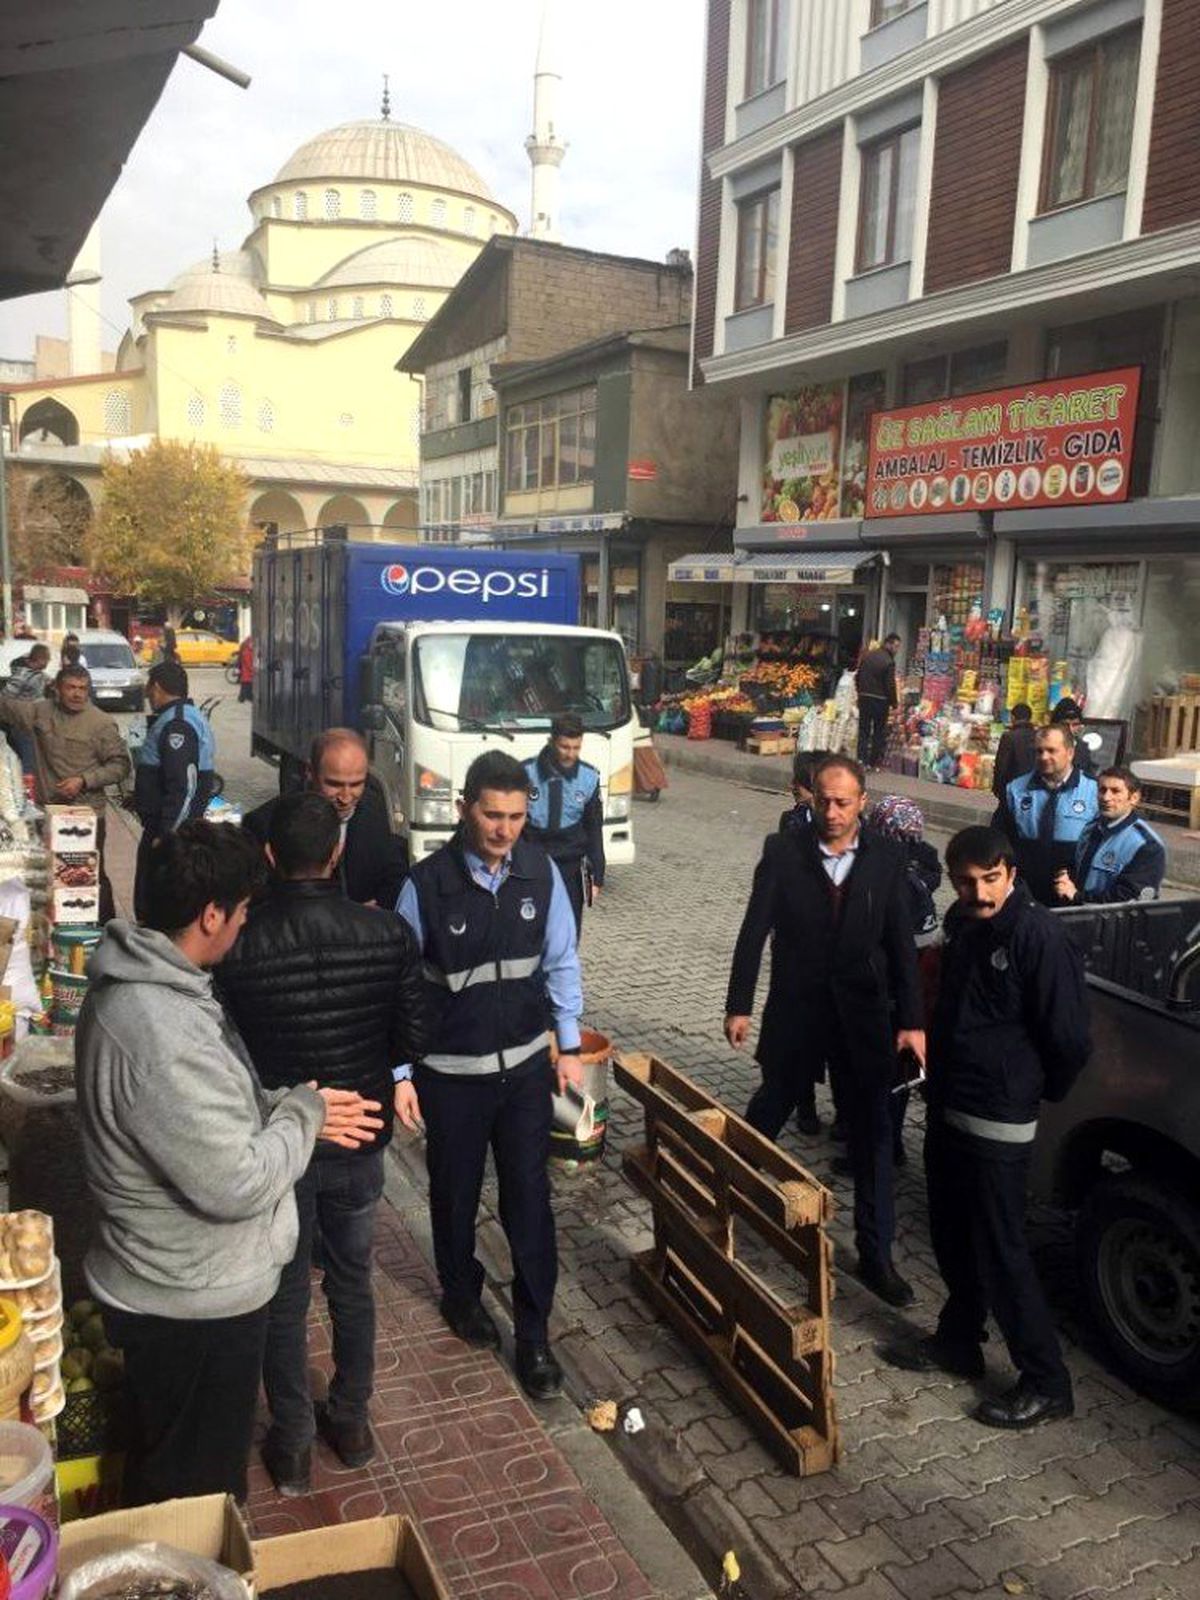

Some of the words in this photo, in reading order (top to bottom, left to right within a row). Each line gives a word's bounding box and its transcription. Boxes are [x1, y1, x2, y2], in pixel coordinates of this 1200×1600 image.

[906, 404, 1003, 447] SAĞLAM
[1008, 384, 1127, 432] TİCARET
[875, 450, 947, 480] AMBALAJ
[962, 434, 1046, 471] TEMİZLİK
[1063, 427, 1122, 459] GIDA
[411, 566, 549, 602] pepsi
